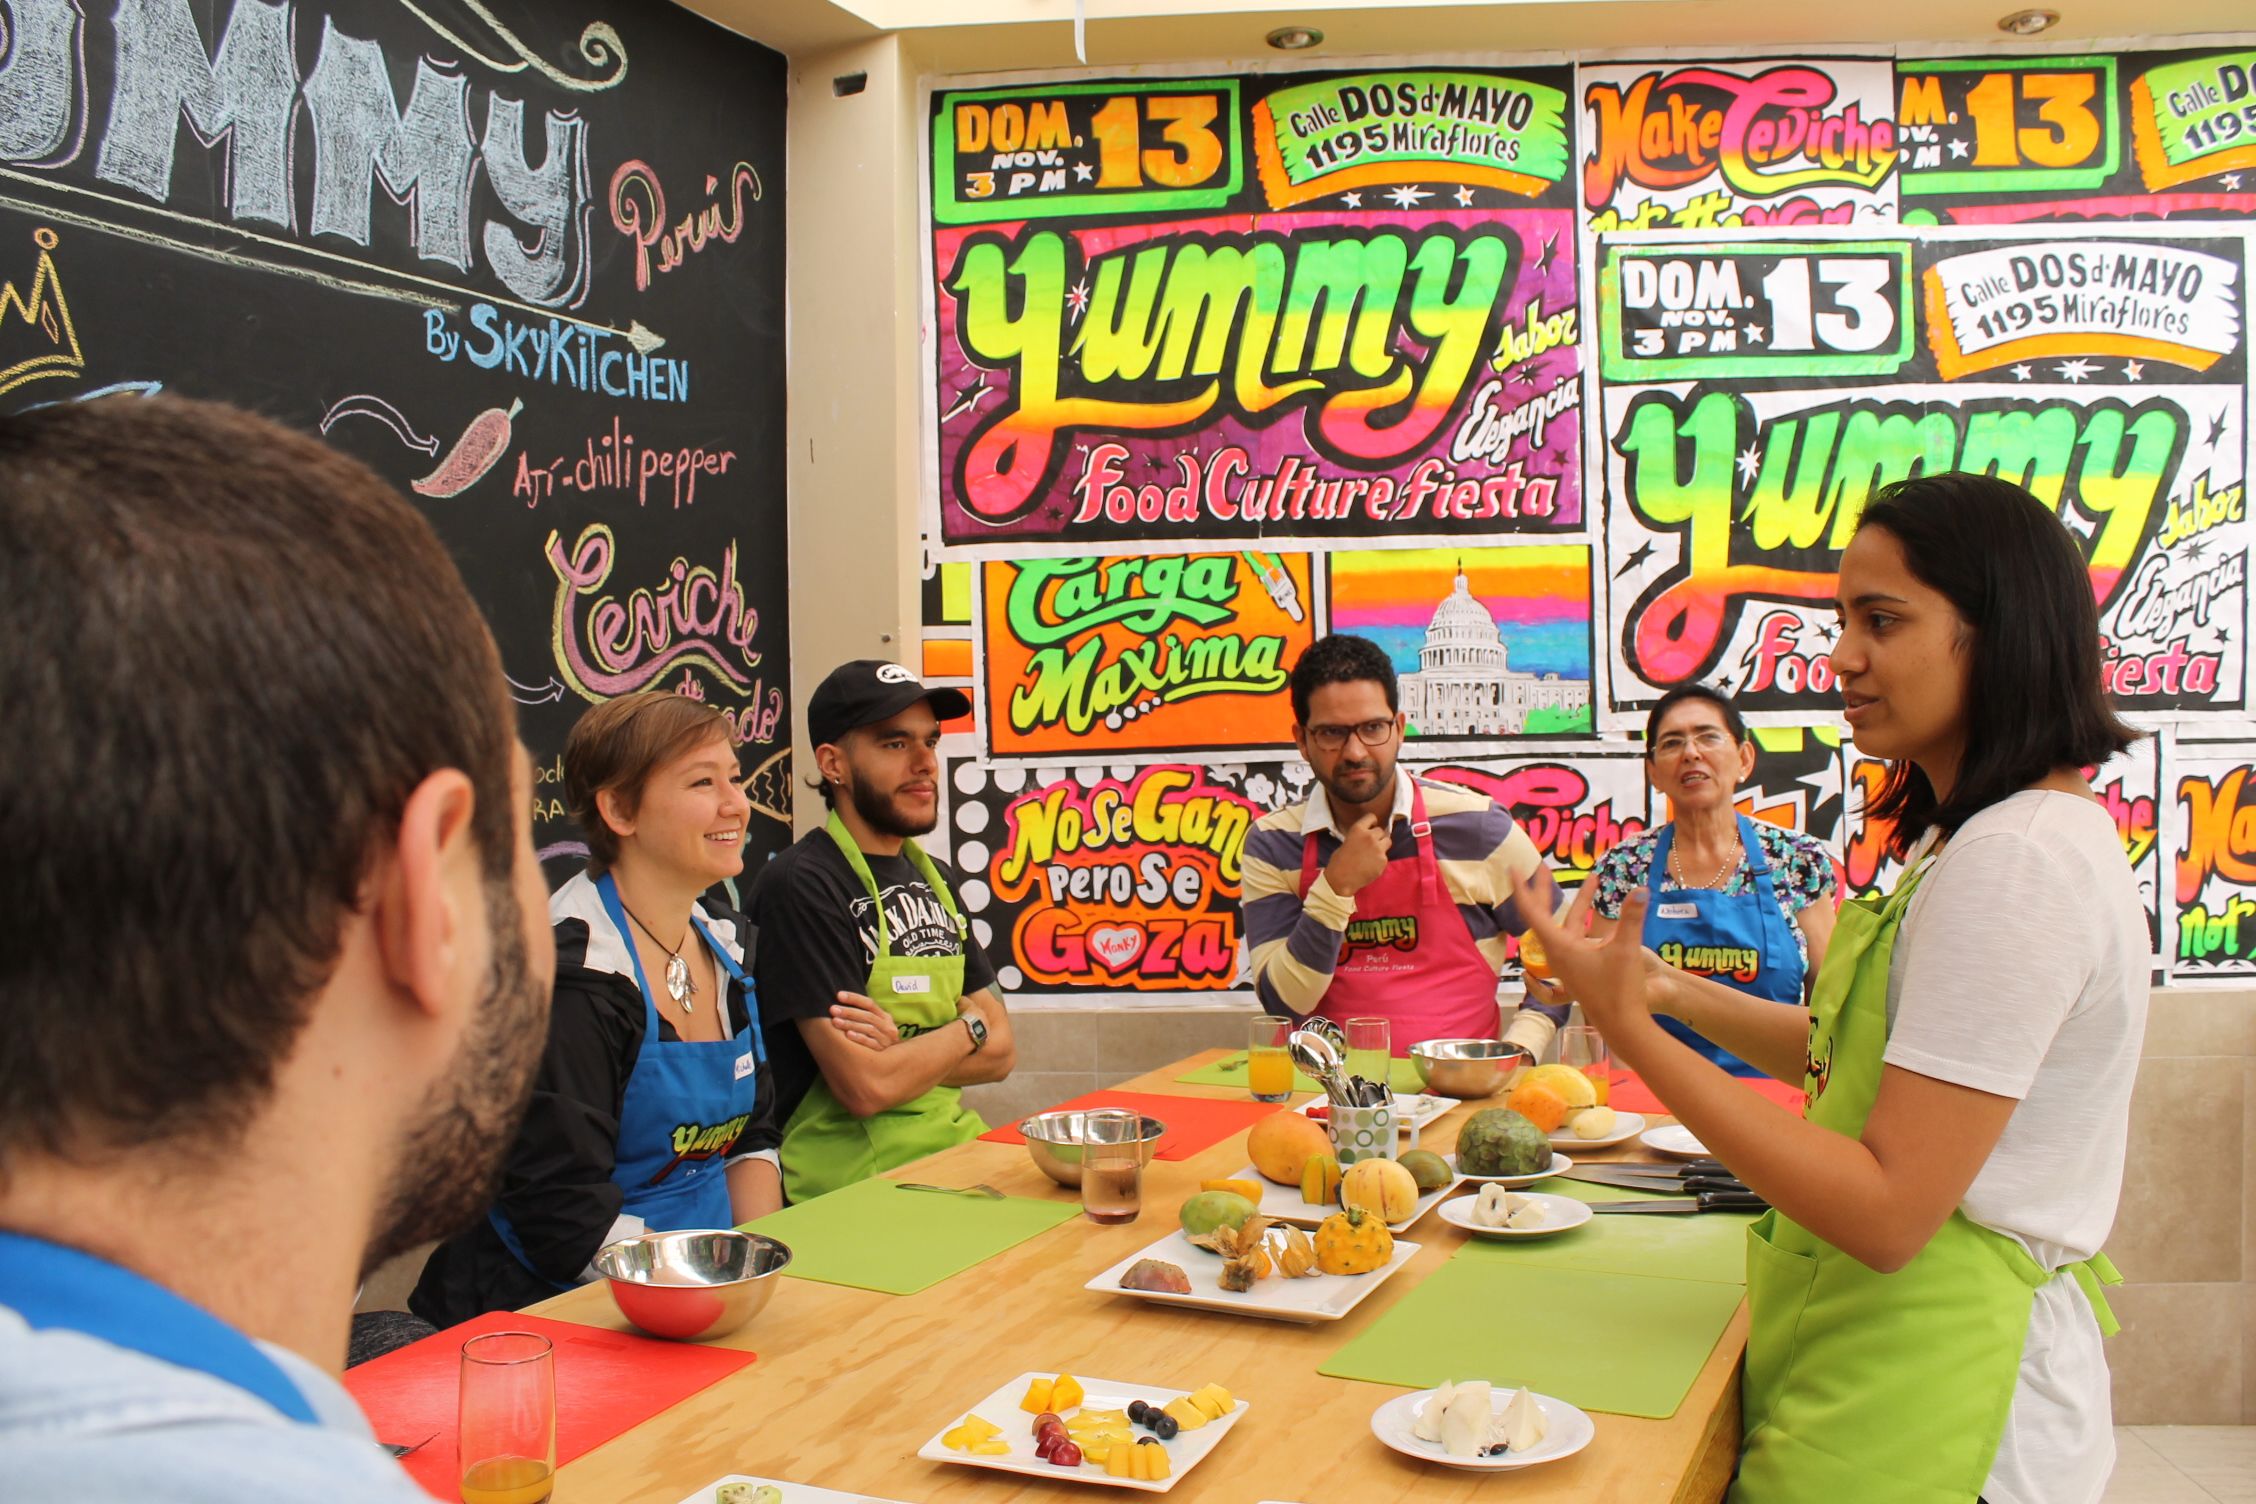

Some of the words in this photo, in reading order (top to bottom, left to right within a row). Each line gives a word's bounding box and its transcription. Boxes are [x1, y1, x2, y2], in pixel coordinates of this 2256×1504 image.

[1290, 103, 1339, 139] Calle
[1338, 82, 1417, 122] DOS
[1966, 73, 2100, 168] 13
[2169, 81, 2221, 119] Calle
[957, 101, 1083, 153] DOM.
[1091, 94, 1222, 188] 13
[991, 150, 1064, 170] NOV.
[1306, 123, 1390, 171] 1195
[1392, 122, 1521, 162] Miraflores
[1585, 74, 1724, 207] Make
[1657, 68, 1899, 195] Ceviche
[965, 172, 995, 198] 3
[1623, 259, 1754, 310] DOM.
[1763, 257, 1894, 352] 13
[1960, 273, 2011, 308] Calle
[2009, 253, 2087, 293] DOS
[423, 309, 460, 362] By
[1633, 329, 1665, 356] 3
[1660, 309, 1735, 328] NOV.
[1977, 295, 2058, 338] 1195
[2063, 293, 2189, 335] Miraflores
[1452, 376, 1580, 464] Elegancia
[639, 447, 737, 509] pepper
[1204, 447, 1395, 521] Culture
[545, 523, 762, 704] Ceviche
[1008, 556, 1238, 644] Carga
[2114, 553, 2243, 643] Elegancia
[1742, 611, 1843, 694] Foo
[1011, 634, 1287, 733] Maxima
[1001, 788, 1082, 882] No
[1083, 790, 1132, 848] Se
[1047, 864, 1131, 904] pero
[1136, 853, 1200, 904] Se
[919, 928, 945, 940] TIME
[1337, 917, 1416, 966] ummy
[1658, 942, 1760, 984] Yummy
